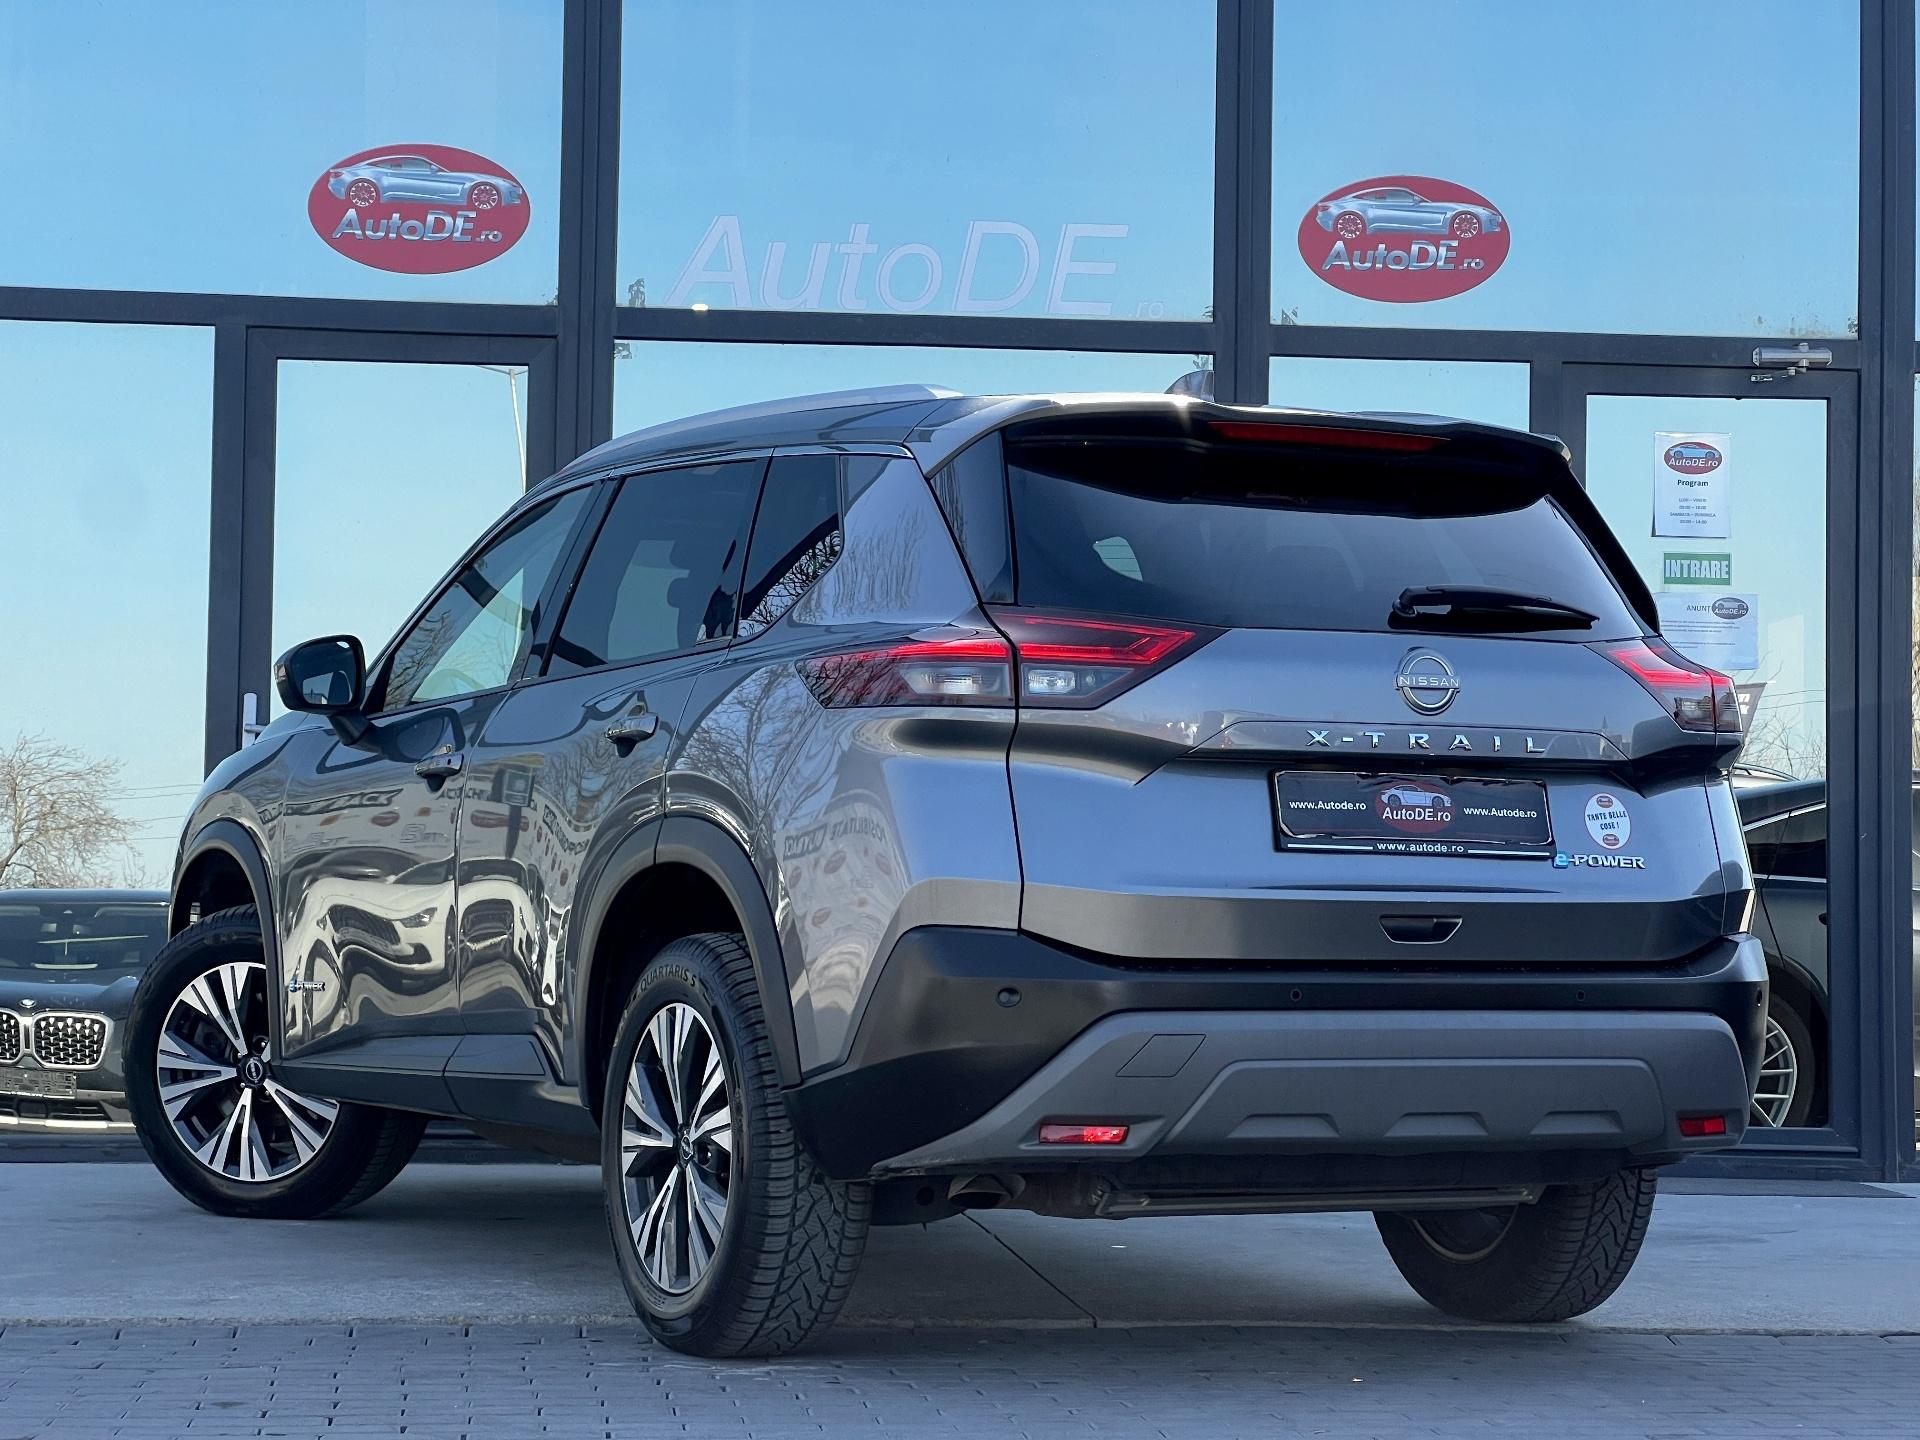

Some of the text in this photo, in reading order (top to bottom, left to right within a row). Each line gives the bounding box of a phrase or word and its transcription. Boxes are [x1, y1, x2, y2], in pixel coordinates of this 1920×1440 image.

[1668, 458, 1719, 468] AutoDE.ro
[1677, 479, 1709, 488] Program
[1665, 559, 1729, 579] INTRARE
[1400, 676, 1459, 688] NISSAN
[1307, 729, 1547, 753] X-TRAIL
[1289, 799, 1367, 811] www.Autode.ro
[1382, 806, 1451, 823] AutoDE.ro
[1463, 805, 1538, 819] www.Autode.ro
[1587, 811, 1627, 821] TANTE BELLE
[1600, 822, 1615, 830] COSE
[1376, 841, 1465, 854] www.autode.ro
[1553, 853, 1646, 869] e-POWER
